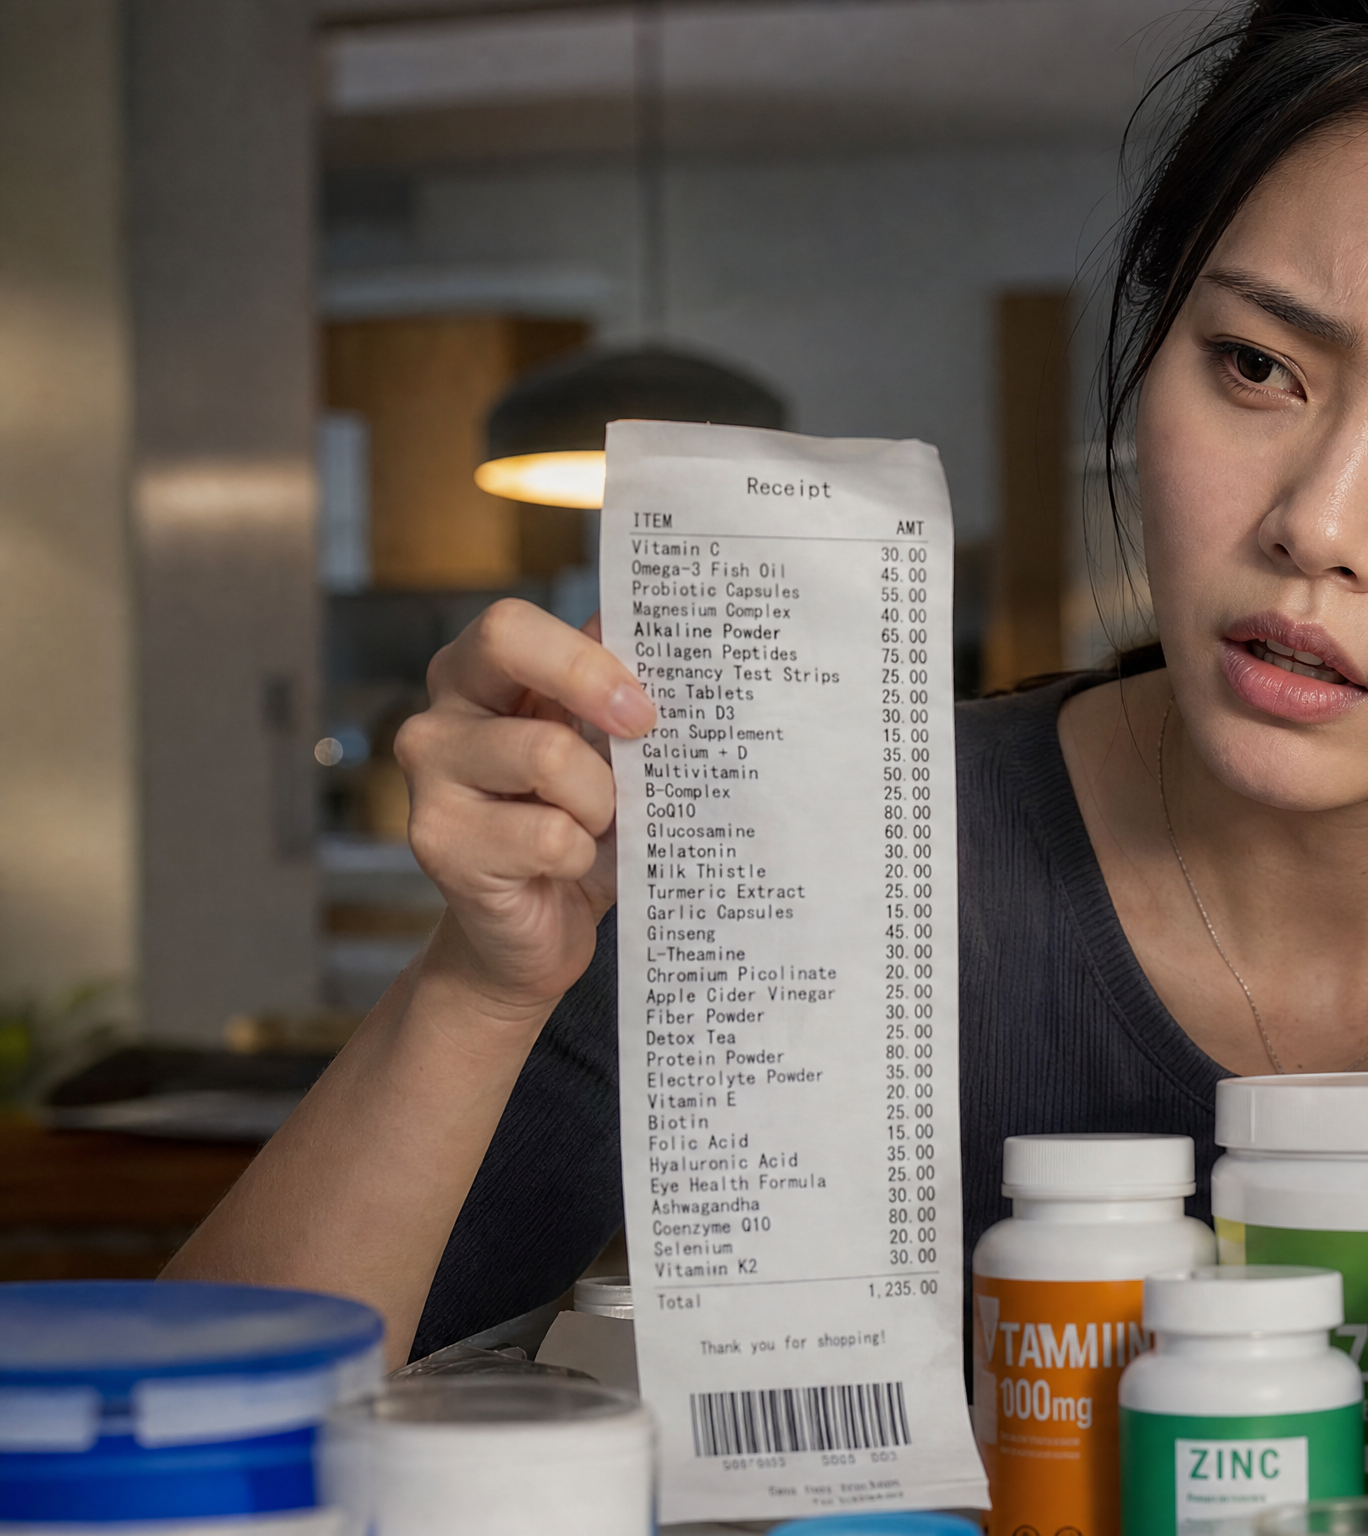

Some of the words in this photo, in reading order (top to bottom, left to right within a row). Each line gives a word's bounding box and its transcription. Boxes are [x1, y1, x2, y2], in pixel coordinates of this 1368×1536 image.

[748, 477, 830, 499] Receipt
[635, 513, 672, 528] ITEM
[896, 521, 924, 535] AMT
[632, 540, 699, 555] Vitamin
[710, 542, 719, 556] C
[882, 547, 926, 563] 30.00
[632, 560, 700, 578] Omega-3
[712, 562, 749, 577] Fish
[760, 563, 784, 578] Oil
[881, 567, 926, 583] 45.00
[633, 580, 716, 597] Probiotic
[726, 582, 799, 600] Capsules
[882, 587, 926, 603] 55.00
[633, 601, 716, 618] Magnesium
[726, 603, 790, 620] Complex
[881, 608, 926, 623] 40.00
[634, 621, 712, 638] Alkaline
[723, 623, 780, 640] Powder
[881, 628, 927, 644] 65.00
[635, 642, 712, 661] Collagen
[723, 644, 797, 662] Peptides
[882, 648, 927, 664] 75.00
[638, 662, 723, 682] Pregnancy
[733, 665, 772, 681] Test
[784, 666, 839, 685] Strips
[882, 668, 927, 684] 25.00
[686, 684, 753, 700] Tablets
[882, 689, 928, 704] 25.00
[651, 704, 705, 719] tamin
[716, 705, 734, 720] D3
[883, 709, 928, 724] 30.00
[643, 726, 678, 739] ron
[689, 724, 783, 742] Supplement
[884, 728, 929, 743] 15.00
[643, 743, 708, 759] Calcium
[738, 745, 747, 760] D
[883, 747, 929, 762] 35.00
[644, 763, 758, 779] Multivitamin
[884, 767, 930, 781] 50.00
[646, 782, 730, 800] B-Complex
[884, 786, 930, 800] 25.00
[647, 803, 695, 818] CoQ10
[884, 805, 931, 820] 80.00
[647, 823, 755, 838] Glucosamine
[885, 824, 931, 839] 60.00
[648, 843, 736, 858] Melatonin
[885, 844, 931, 858] 30.00
[648, 864, 685, 878] Milk
[697, 863, 765, 878] Thistle
[885, 864, 932, 878] 20.00
[648, 884, 725, 899] Turmeric
[737, 884, 805, 899] Extract
[885, 883, 932, 898] 25.00
[647, 905, 706, 920] Garlic
[717, 904, 793, 921] Capsules
[887, 904, 932, 918] 15.00
[647, 925, 715, 942] Ginseng
[885, 923, 932, 939] 45.00
[886, 944, 932, 959] 30.00
[647, 967, 727, 983] Chromium
[738, 966, 836, 981] Picolinate
[886, 964, 932, 979] 20.00
[646, 988, 695, 1006] Apple
[707, 987, 755, 1002] Cider
[768, 986, 834, 1003] Vinegar
[886, 984, 932, 999] 25.00
[647, 1009, 694, 1024] Fiber
[707, 1008, 764, 1023] Powder
[886, 1004, 932, 1019] 30.00
[647, 1030, 694, 1045] Detox
[707, 1029, 735, 1044] Tea
[887, 1024, 932, 1039] 25.00
[647, 1051, 715, 1067] Protein
[726, 1050, 783, 1065] Powder
[886, 1044, 932, 1059] 80.00
[648, 1071, 755, 1088] Electrolyte
[767, 1068, 822, 1083] Powder
[887, 1064, 932, 1079] 35.00
[648, 1093, 716, 1109] Vitamin
[727, 1091, 736, 1106] E
[887, 1084, 933, 1099] 20.00
[648, 1114, 708, 1130] Biotin
[887, 1103, 933, 1119] 25.00
[649, 1136, 697, 1151] Folic
[708, 1134, 748, 1149] Acid
[888, 1124, 933, 1140] 15.00
[650, 1157, 747, 1175] Hyaluronic
[759, 1153, 797, 1168] Acid
[888, 1144, 934, 1161] 35.00
[651, 1178, 678, 1196] Eye
[690, 1176, 748, 1192] Health
[759, 1174, 826, 1189] Formula
[888, 1165, 935, 1182] 25.00
[652, 1197, 759, 1216] Ashwagandha
[889, 1186, 935, 1203] 30.00
[653, 1220, 731, 1236] Coenzyme
[742, 1216, 770, 1232] Q10
[889, 1207, 936, 1224] 80.00
[655, 1242, 732, 1256] Selenium
[890, 1227, 936, 1244] 20.00
[738, 1259, 756, 1273] K2
[890, 1248, 936, 1265] 30.00
[657, 1293, 700, 1309] Total
[870, 1280, 937, 1297] 1,235.00
[700, 1341, 740, 1355] Thank
[751, 1342, 774, 1354] you
[786, 1336, 805, 1348] for
[819, 1331, 884, 1347] shopping!
[1190, 1449, 1279, 1479] ZINC
